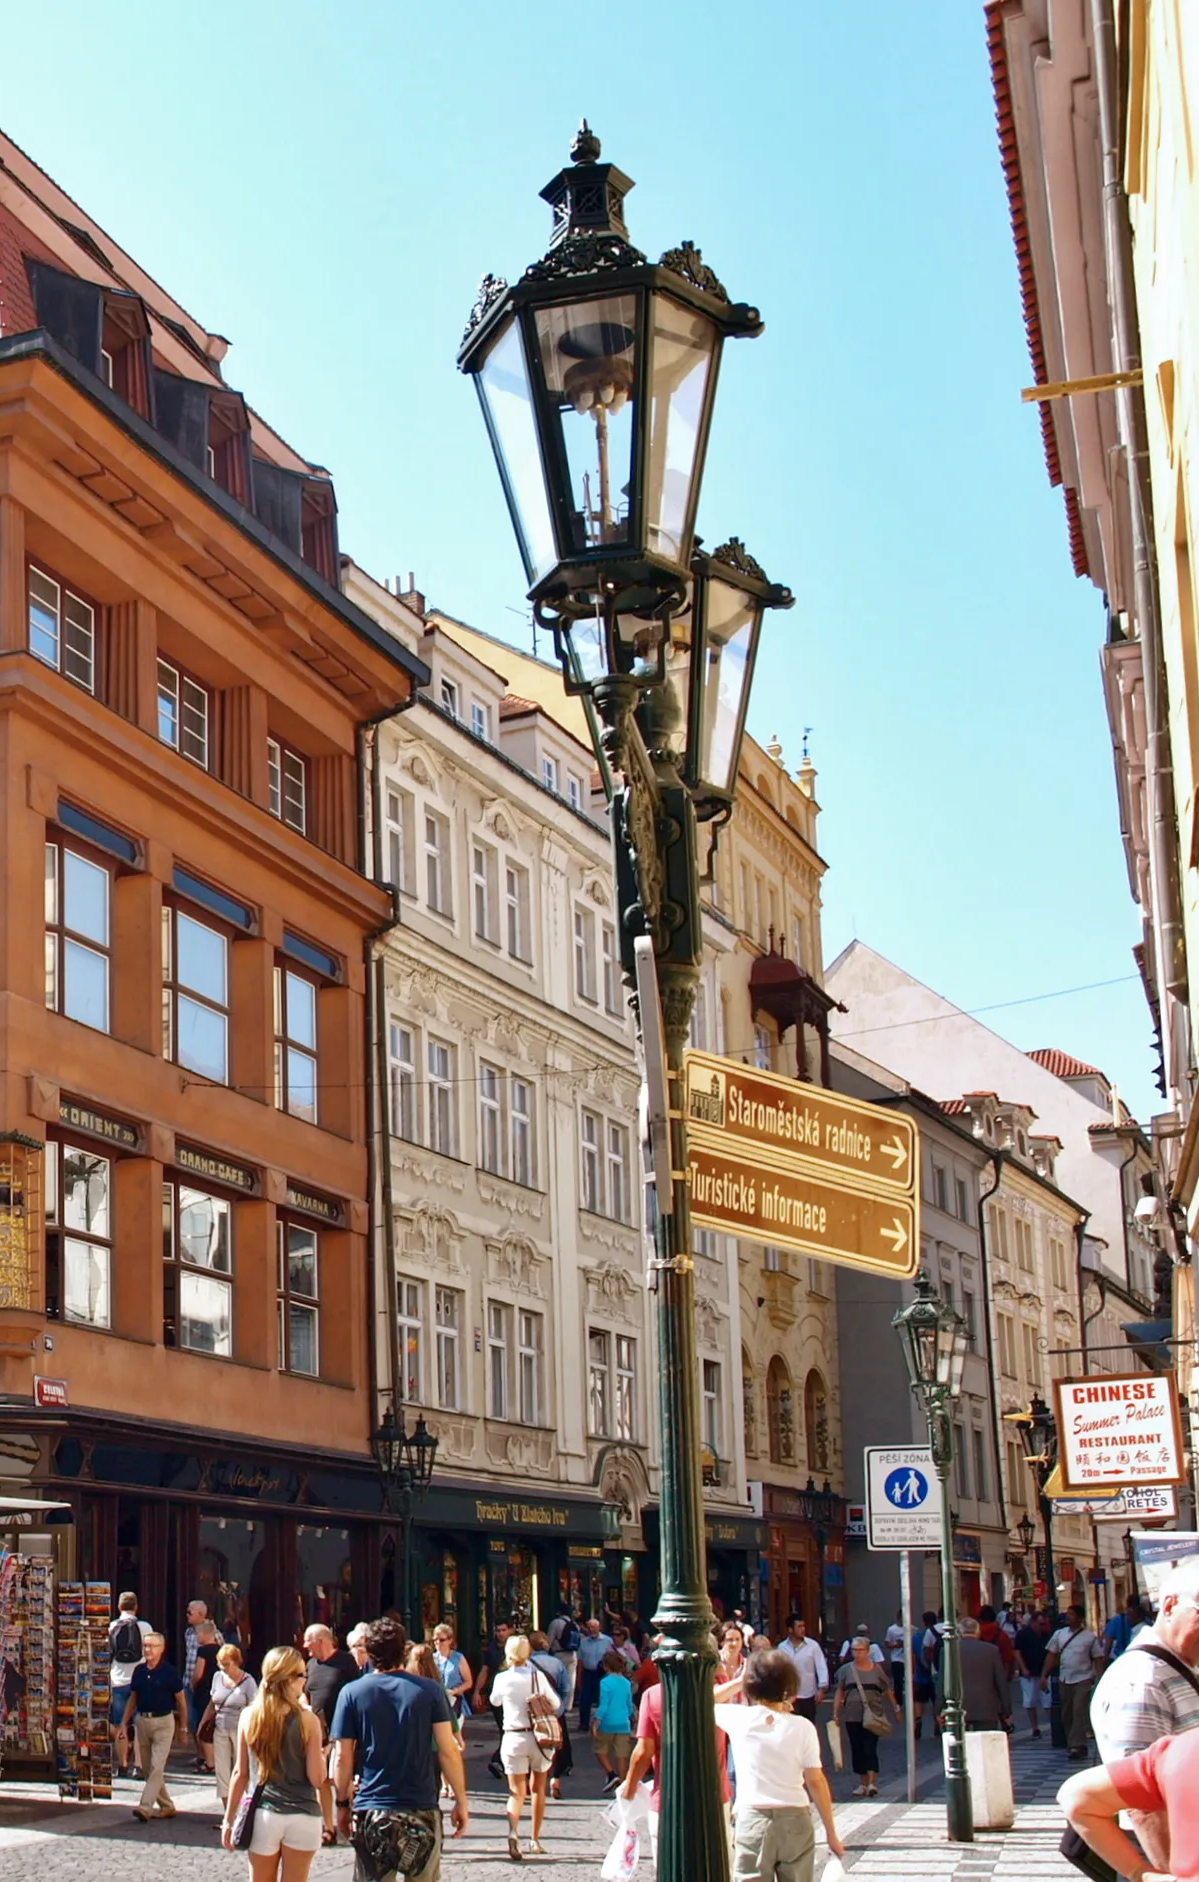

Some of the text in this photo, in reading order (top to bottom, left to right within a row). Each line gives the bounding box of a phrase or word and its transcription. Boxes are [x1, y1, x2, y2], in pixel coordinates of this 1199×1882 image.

[70, 1108, 121, 1138] ORIENT
[729, 1085, 871, 1161] Staroměstská radnice
[180, 1150, 244, 1185] GRAND CAFE
[690, 1161, 826, 1233] Turistické informace
[1072, 1383, 1156, 1404] CHINESE
[1073, 1403, 1165, 1435] Summer Palace
[1079, 1433, 1162, 1448] RESTAURANT
[903, 1453, 930, 1464] ZÓNA
[1081, 1465, 1167, 1478] 20m Passage
[1128, 1497, 1168, 1508] RETES
[847, 1524, 866, 1533] KB
